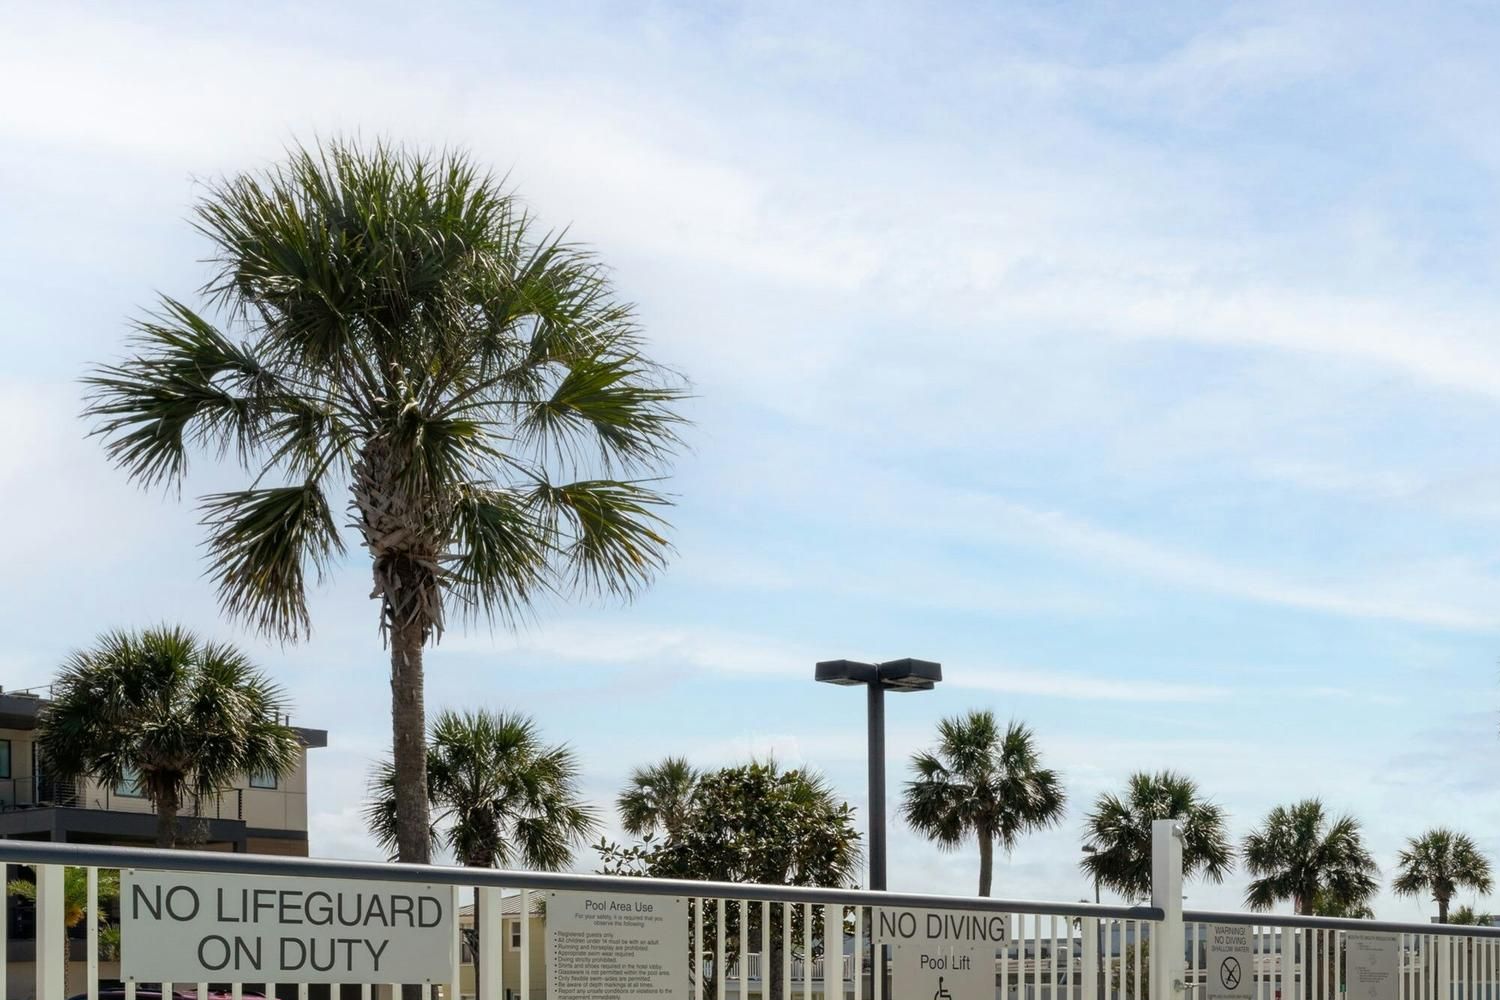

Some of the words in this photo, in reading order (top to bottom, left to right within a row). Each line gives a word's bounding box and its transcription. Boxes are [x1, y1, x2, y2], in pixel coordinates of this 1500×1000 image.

[133, 884, 200, 921] NO
[217, 888, 442, 928] LIFEGUARD
[586, 900, 606, 910] Pool
[610, 901, 631, 911] Area
[635, 902, 653, 912] Use
[880, 912, 916, 938] NO
[927, 914, 1004, 941] DIVING
[1215, 927, 1246, 935] WARNING!
[1215, 936, 1224, 944] NO
[1226, 937, 1246, 945] DIVING
[197, 935, 262, 970] ON
[280, 938, 388, 971] DUTY
[921, 955, 947, 969] Pool
[952, 955, 970, 970] Lift
